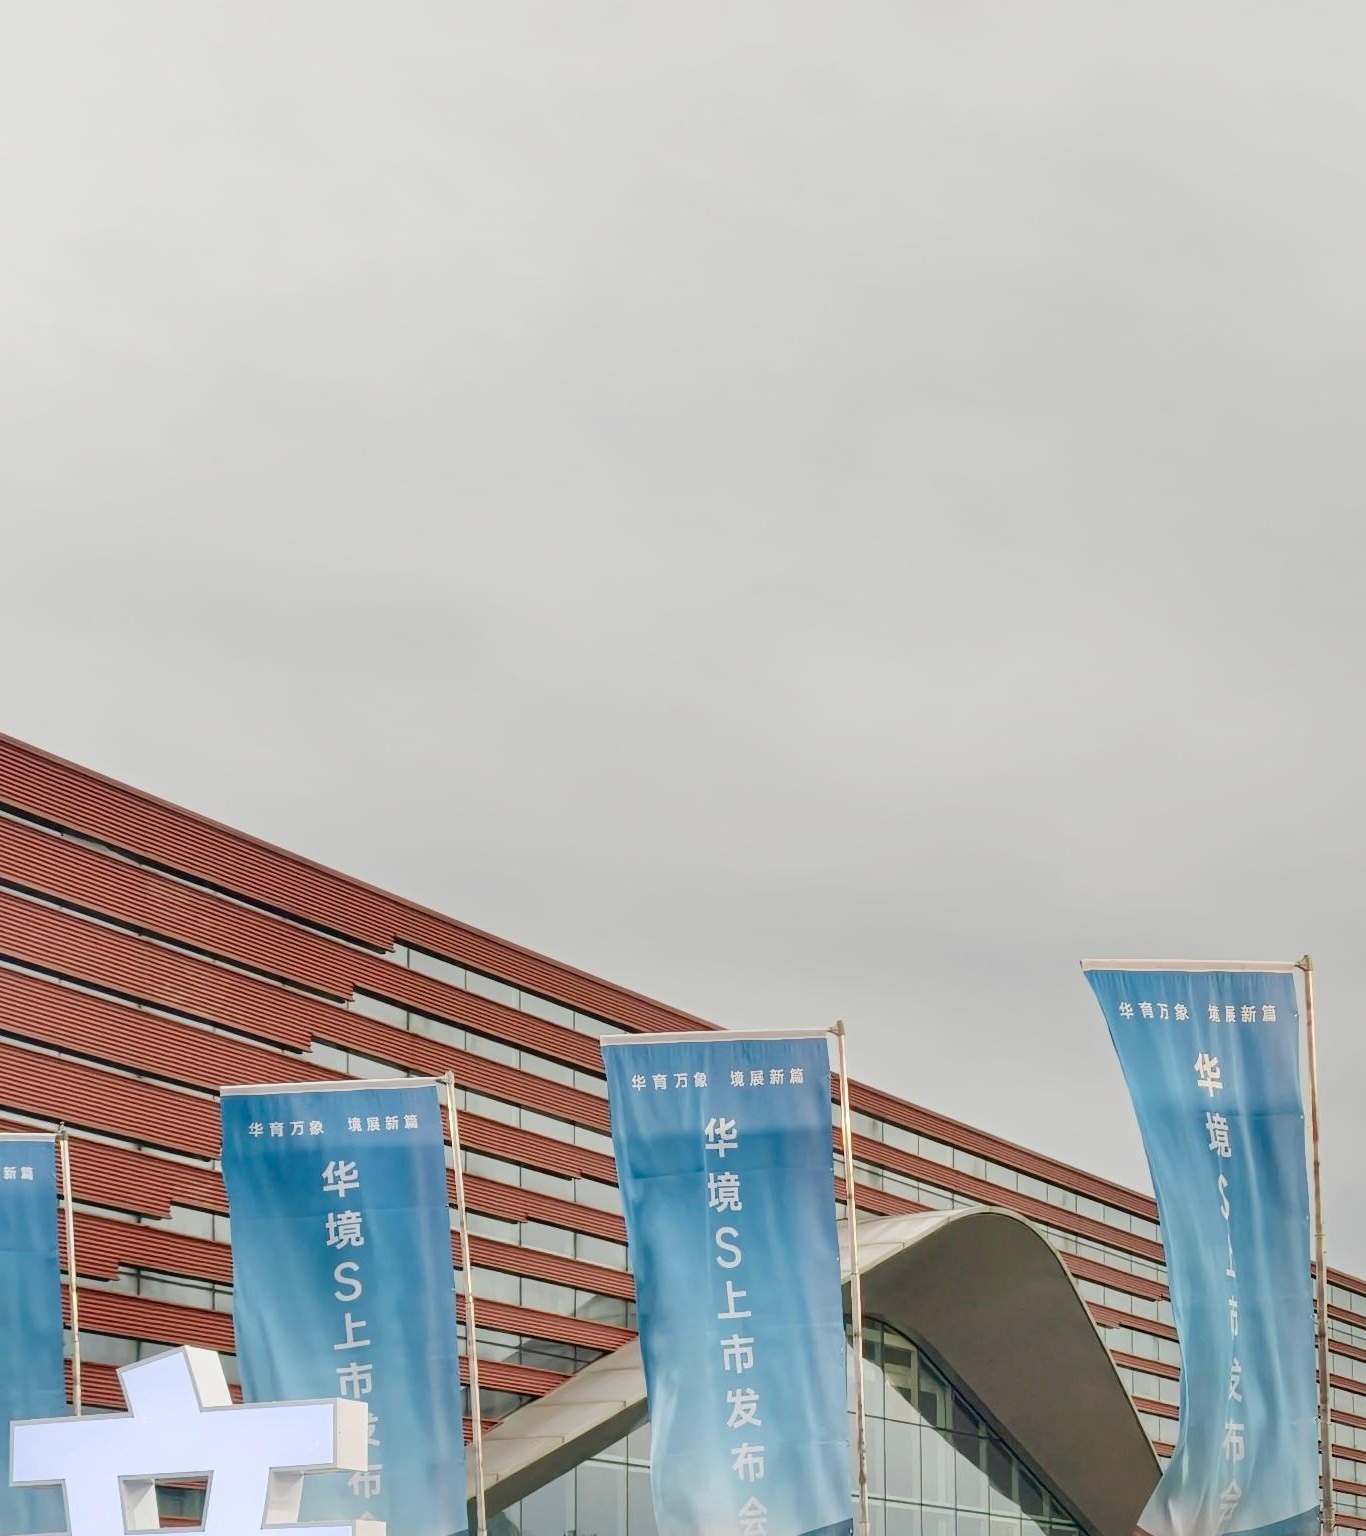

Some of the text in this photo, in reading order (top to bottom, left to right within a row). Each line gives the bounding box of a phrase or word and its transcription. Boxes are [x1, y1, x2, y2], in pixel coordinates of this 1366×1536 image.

[1118, 1001, 1277, 1023] 华育万象 境展新篇
[630, 1066, 805, 1092] 华育万象 境展新篇
[247, 1112, 419, 1138] 华育万象 境展新篇
